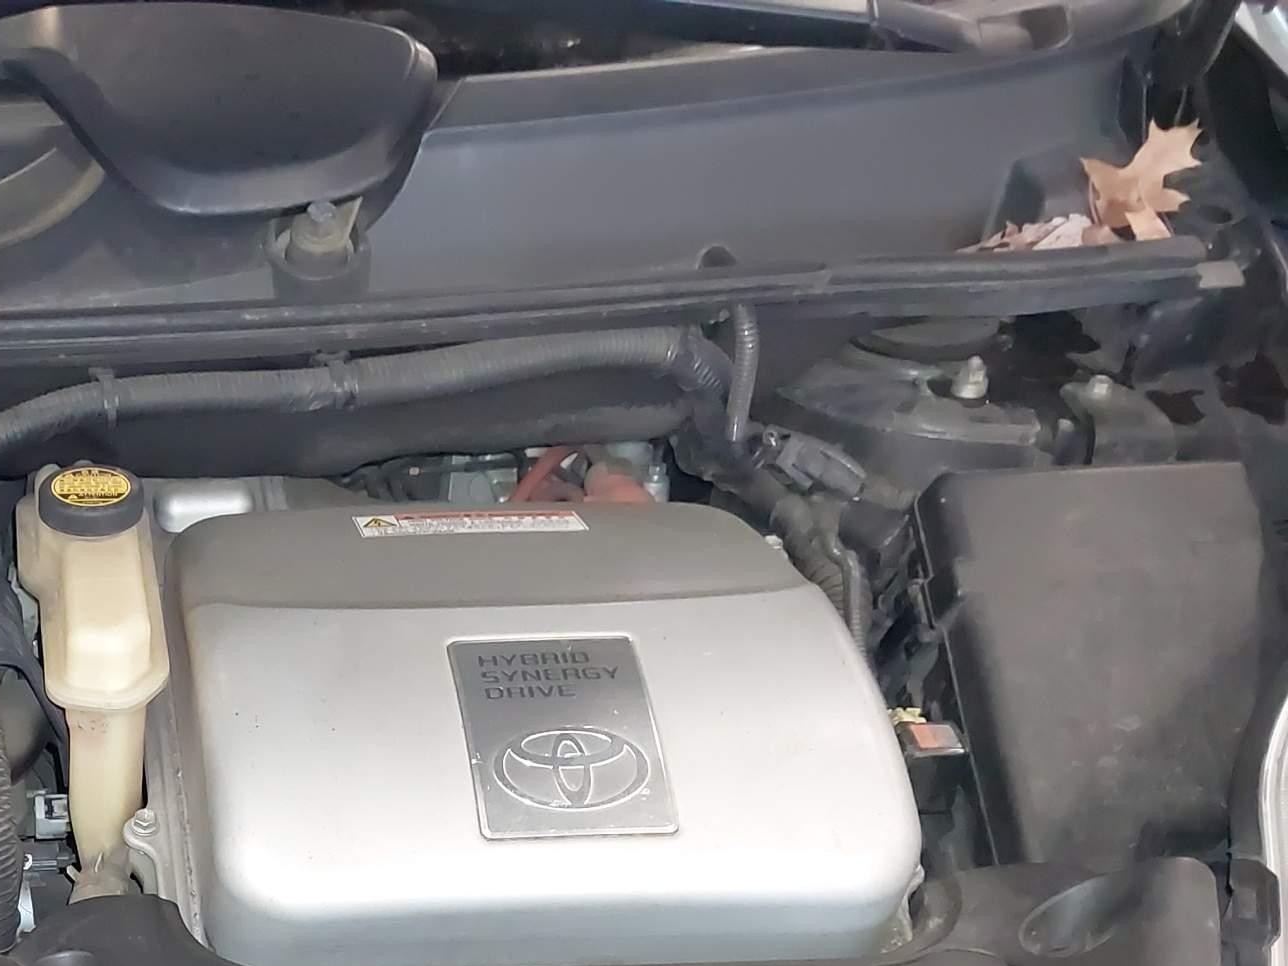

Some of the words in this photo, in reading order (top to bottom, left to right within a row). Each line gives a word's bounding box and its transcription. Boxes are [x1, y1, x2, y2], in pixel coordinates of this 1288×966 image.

[478, 652, 590, 666] HYBRID
[481, 667, 618, 683] SYNERGY
[485, 685, 576, 699] DRIVE
